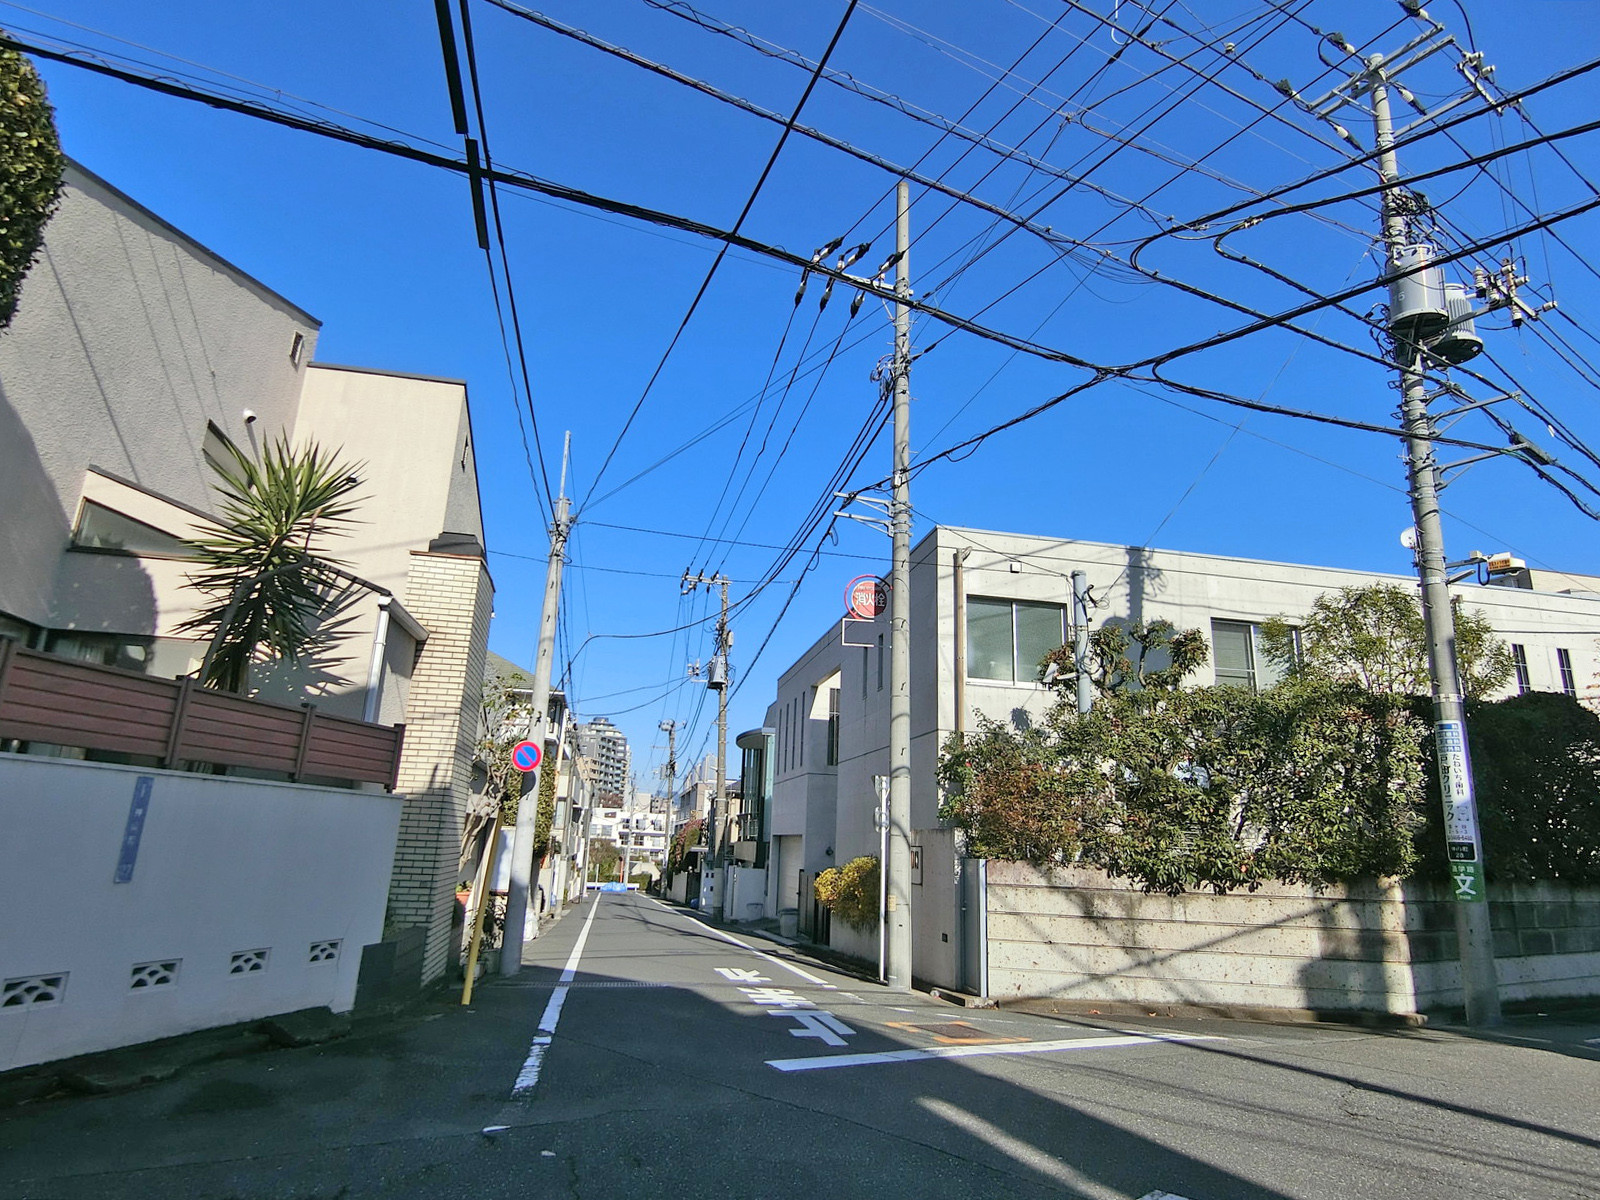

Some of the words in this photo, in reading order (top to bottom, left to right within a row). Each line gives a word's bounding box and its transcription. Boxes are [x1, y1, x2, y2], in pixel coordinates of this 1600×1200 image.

[855, 592, 885, 606] 消火栓
[1453, 873, 1477, 895] 文
[713, 966, 857, 1047] 止まれ
